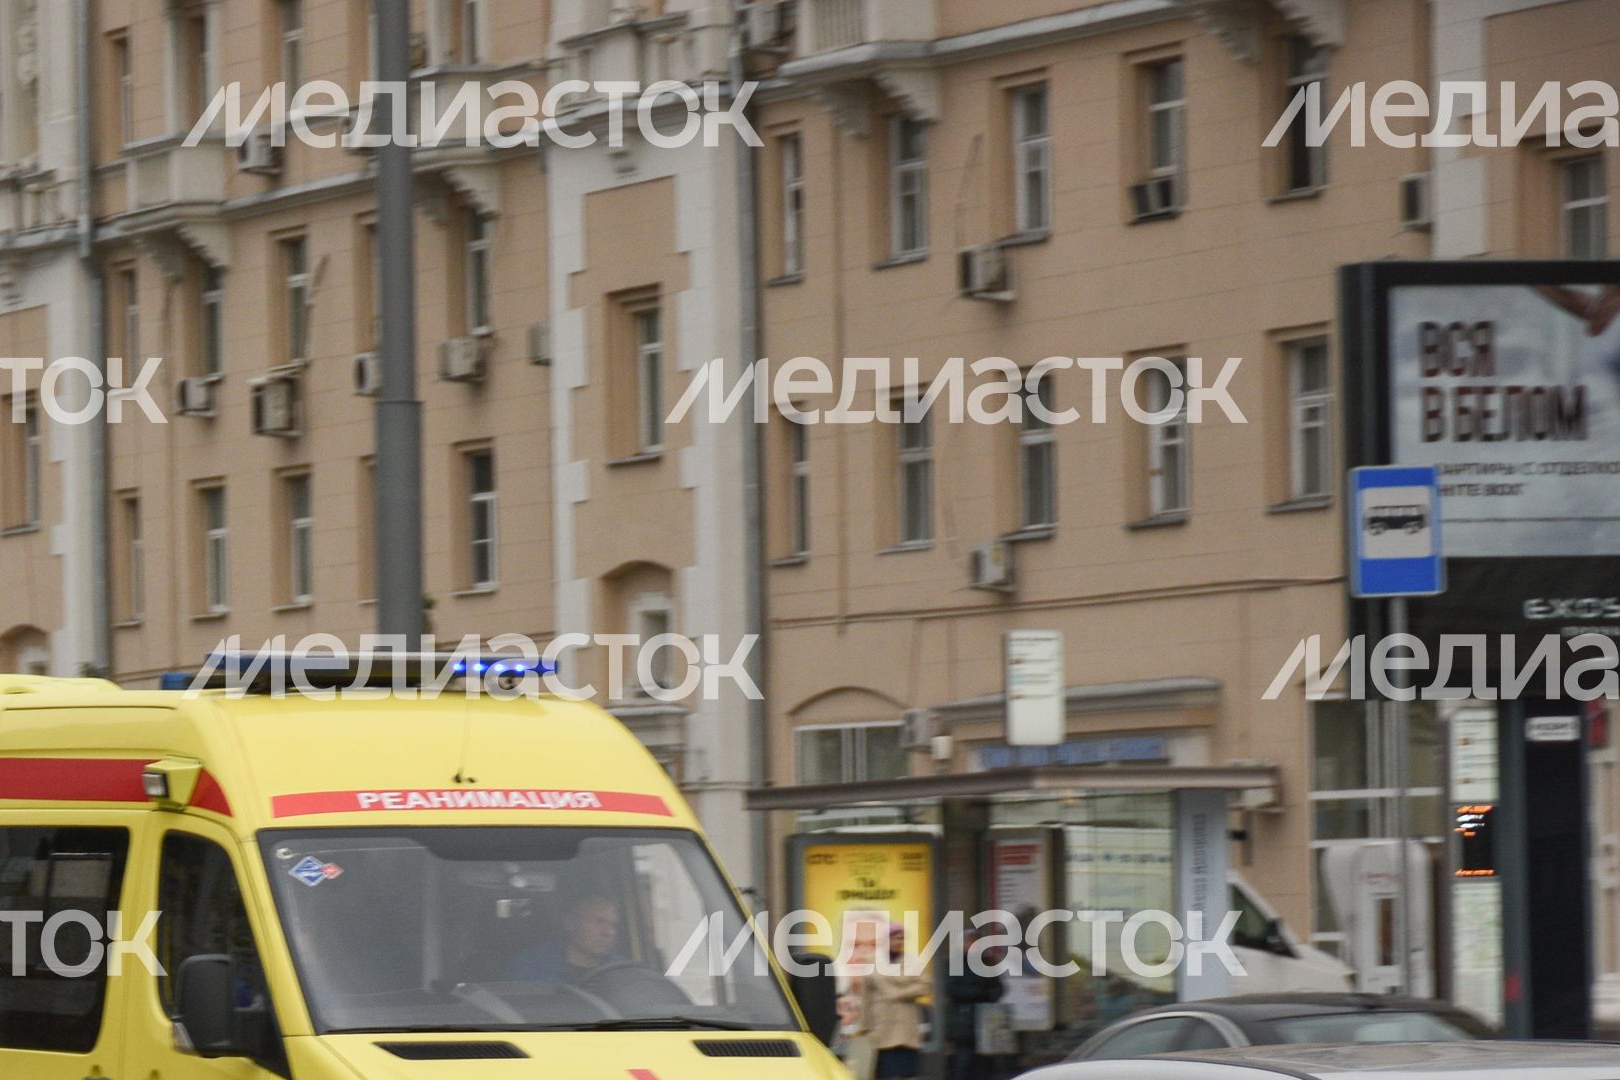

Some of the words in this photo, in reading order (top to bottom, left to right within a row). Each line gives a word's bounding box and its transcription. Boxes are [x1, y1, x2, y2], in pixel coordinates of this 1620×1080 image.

[1419, 321, 1495, 378] ВСЯ
[1421, 385, 1445, 443] В
[1452, 384, 1587, 443] БЕЛОМ
[356, 790, 603, 810] РЕАНИМАЦИЯ
